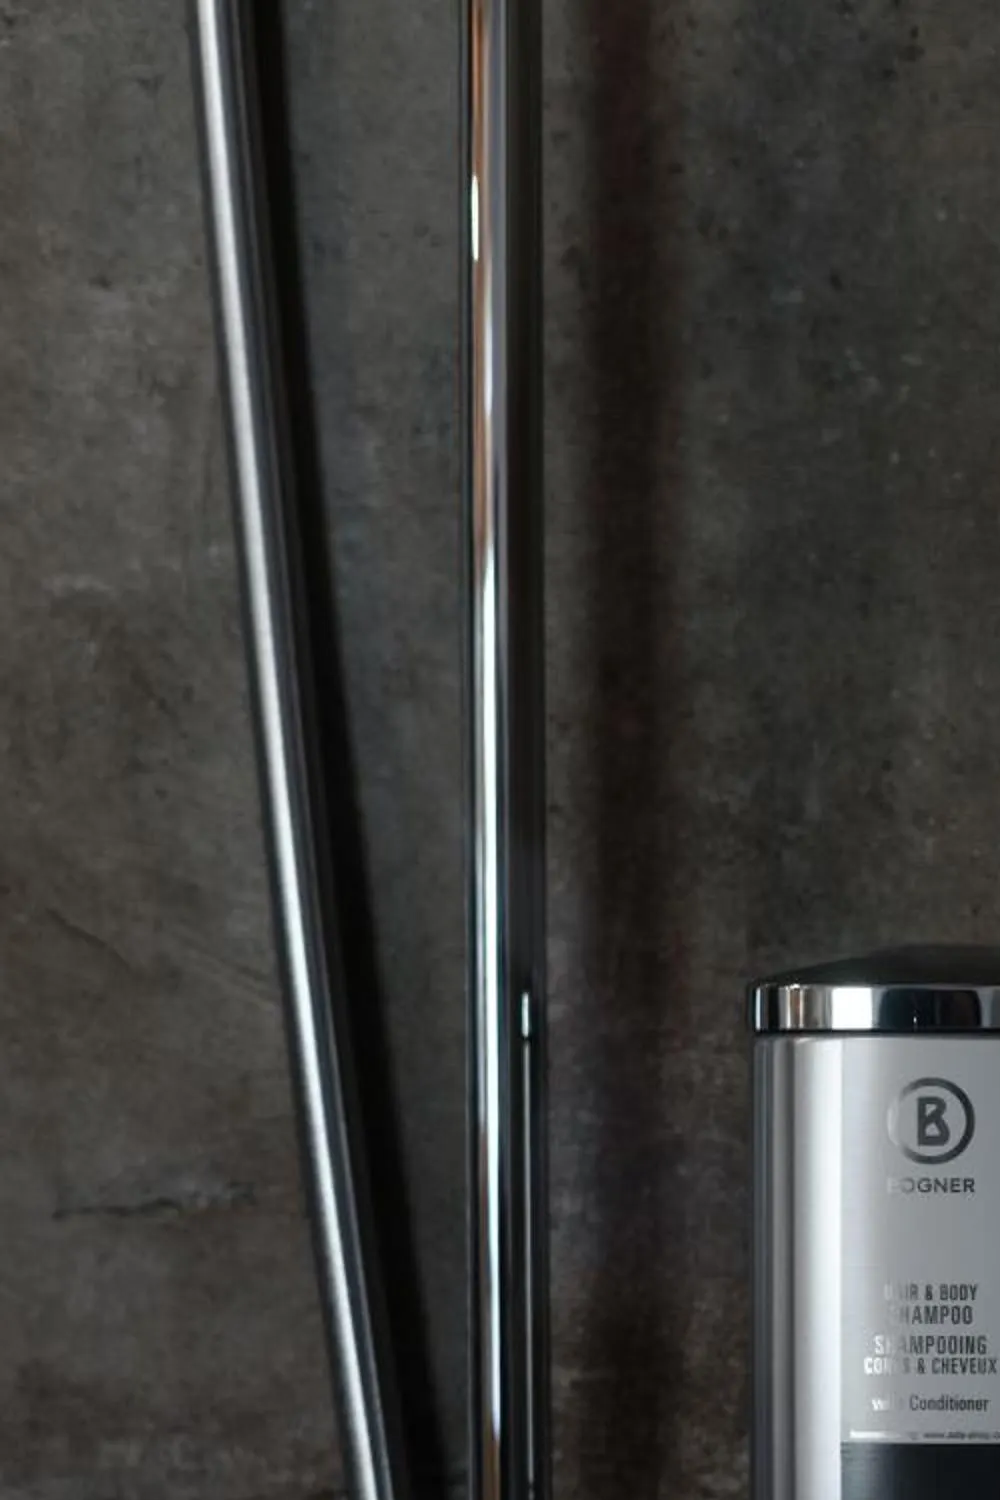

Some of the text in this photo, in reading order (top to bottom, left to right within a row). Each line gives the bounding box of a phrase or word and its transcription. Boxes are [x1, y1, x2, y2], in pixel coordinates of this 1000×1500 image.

[924, 1284, 933, 1301] &
[939, 1284, 979, 1301] BODY
[888, 1305, 974, 1325] HAMPOO
[863, 1357, 998, 1375] COS & CHEVEUX
[908, 1394, 991, 1411] Conditioner
